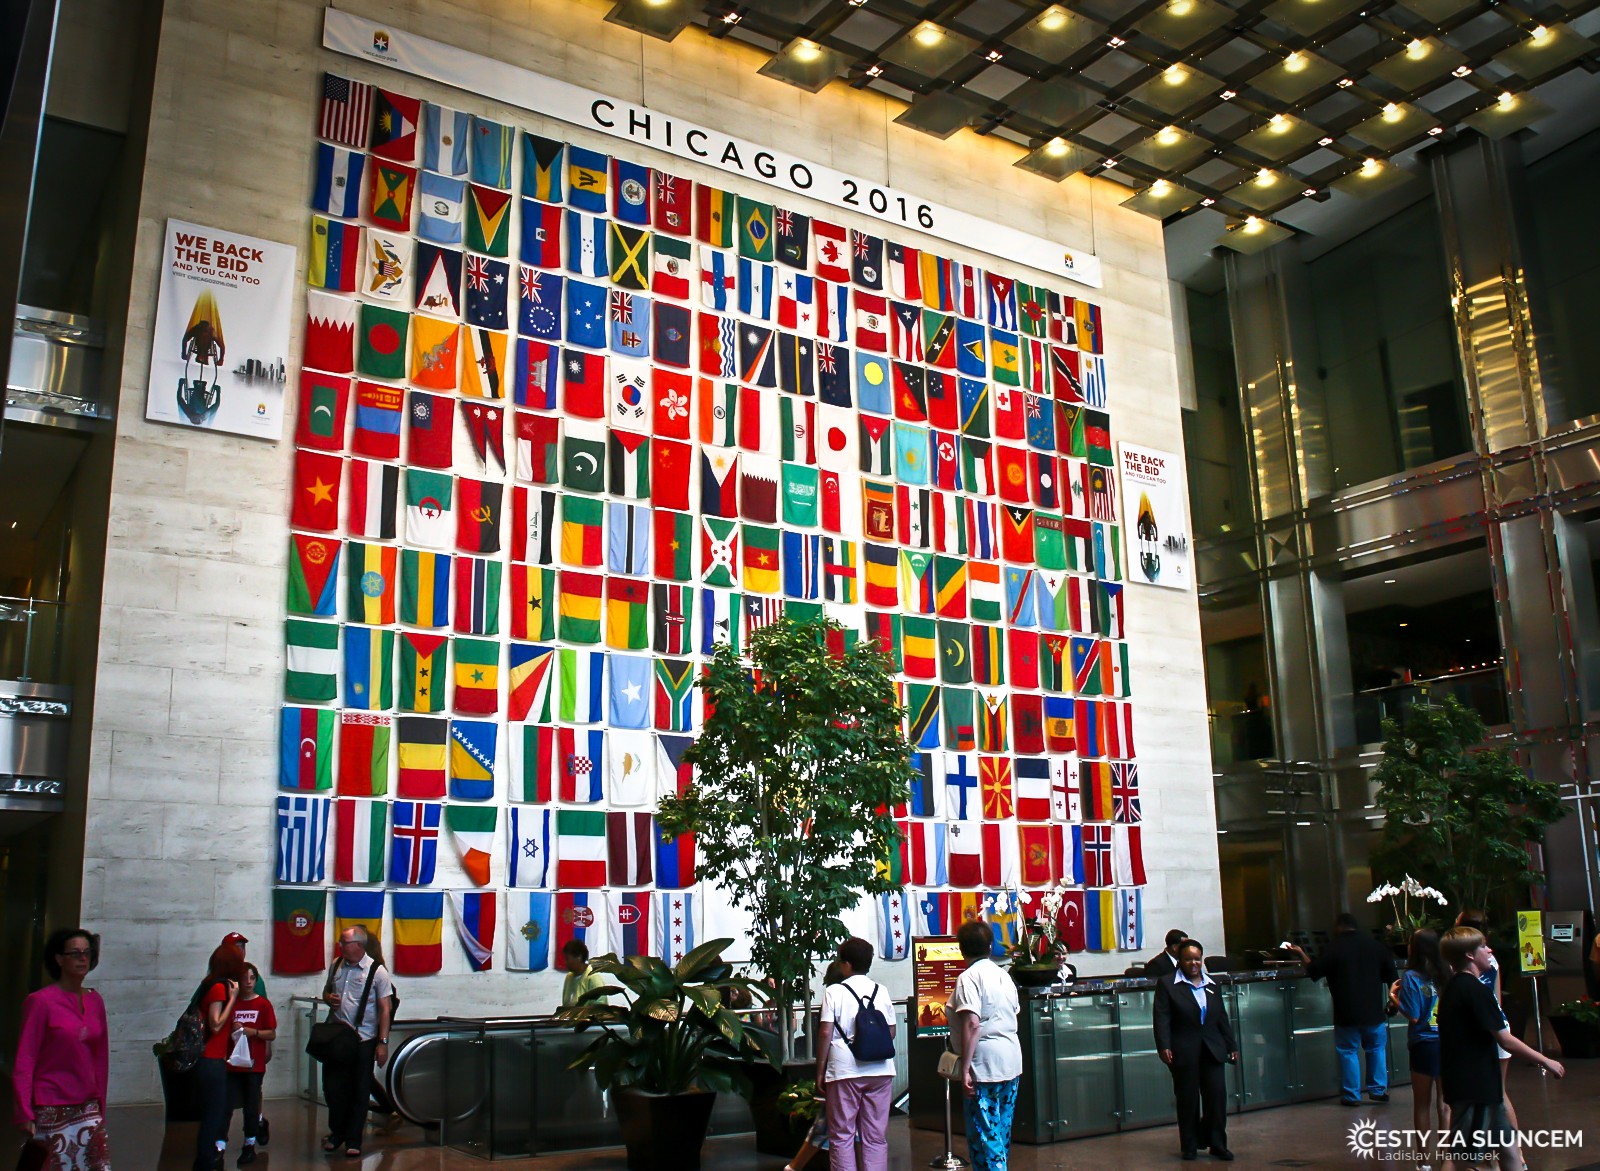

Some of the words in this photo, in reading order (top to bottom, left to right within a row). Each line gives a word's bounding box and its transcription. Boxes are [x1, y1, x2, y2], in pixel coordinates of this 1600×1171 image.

[590, 98, 815, 190] CHICAGO
[841, 179, 935, 230] 2016
[174, 246, 211, 266] THE
[216, 255, 249, 273] BID
[176, 231, 207, 250] WE
[212, 240, 264, 264] BACK
[172, 261, 193, 272] AND
[196, 266, 216, 277] YOU
[218, 270, 239, 281] CAN
[241, 275, 261, 286] TOO
[1124, 451, 1139, 461] WE
[1141, 455, 1165, 468] BACK
[1125, 461, 1142, 472] THE
[1145, 465, 1159, 475] BID
